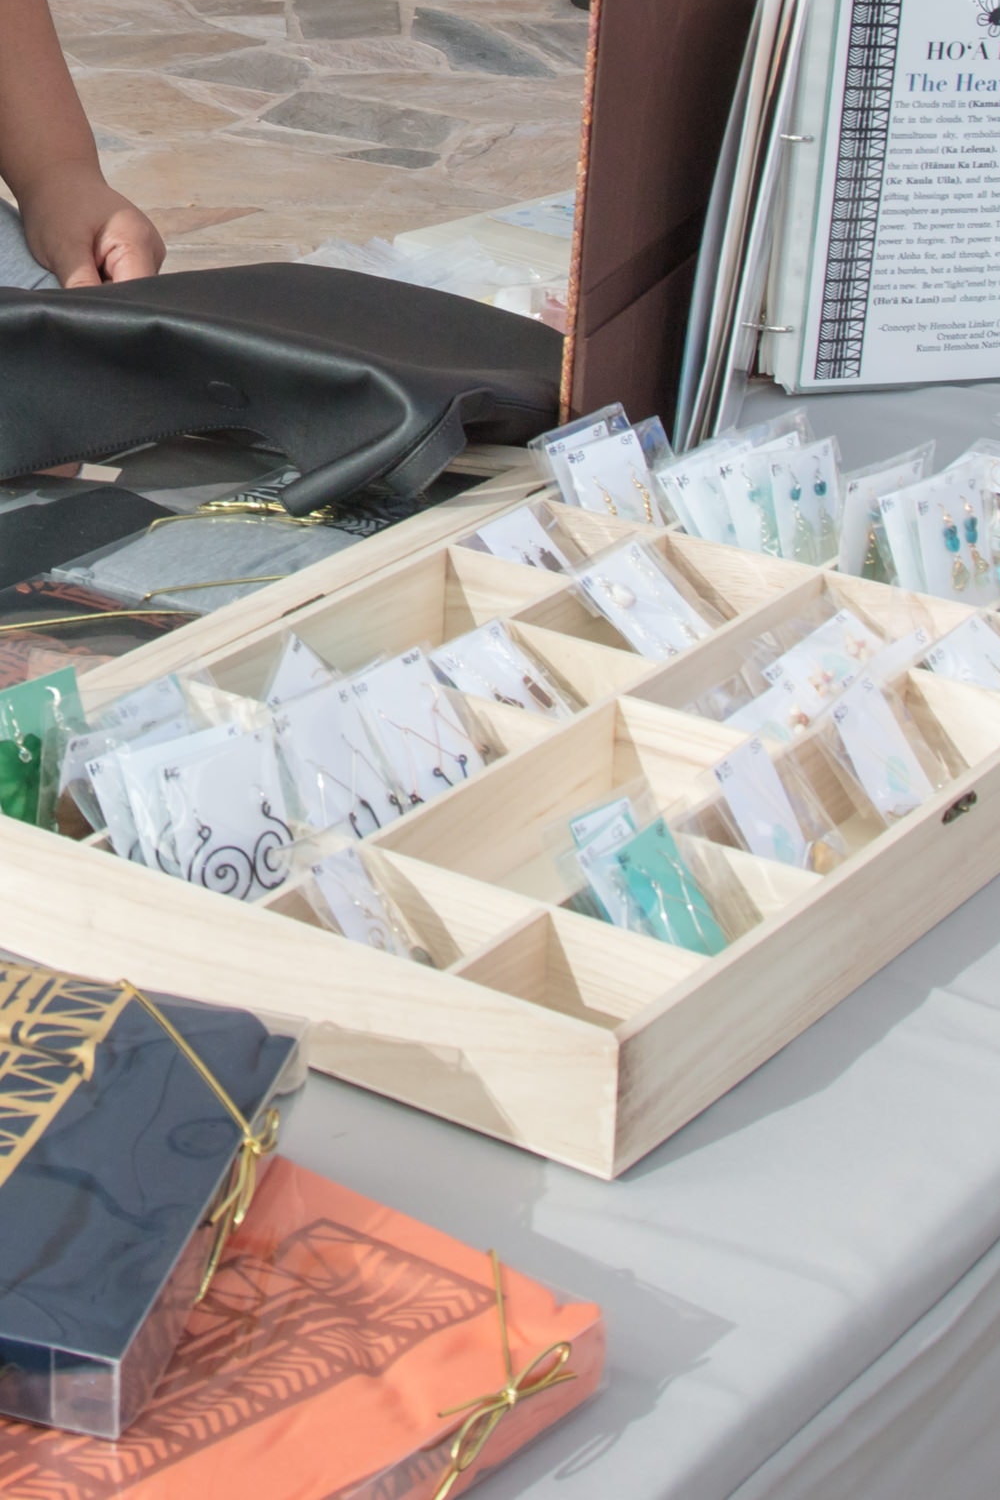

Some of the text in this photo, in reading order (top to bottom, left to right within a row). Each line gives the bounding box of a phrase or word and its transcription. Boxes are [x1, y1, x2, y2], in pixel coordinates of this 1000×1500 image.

[906, 73, 948, 92] The
[895, 100, 909, 108] The
[912, 100, 940, 108] Clouds
[942, 100, 956, 108] roll
[958, 100, 967, 108] in
[893, 116, 904, 124] for
[968, 115, 983, 123] The
[941, 146, 958, 154] (Ka
[888, 162, 900, 170] the
[958, 161, 970, 169] Ka
[972, 160, 999, 169] Lani).
[886, 177, 901, 186] (Ke
[984, 175, 1000, 183] then
[913, 222, 928, 230] The
[930, 222, 955, 231] power
[878, 238, 902, 246] power
[906, 237, 914, 245] to
[967, 236, 991, 244] power
[916, 296, 940, 304] Lani)
[960, 294, 986, 303] change
[918, 322, 927, 331] by
[930, 321, 966, 330] Henohea
[969, 320, 994, 329] Linker
[937, 332, 967, 341] Creator
[969, 331, 985, 339] and
[916, 344, 941, 352] Kumu
[943, 343, 979, 352] Henohea
